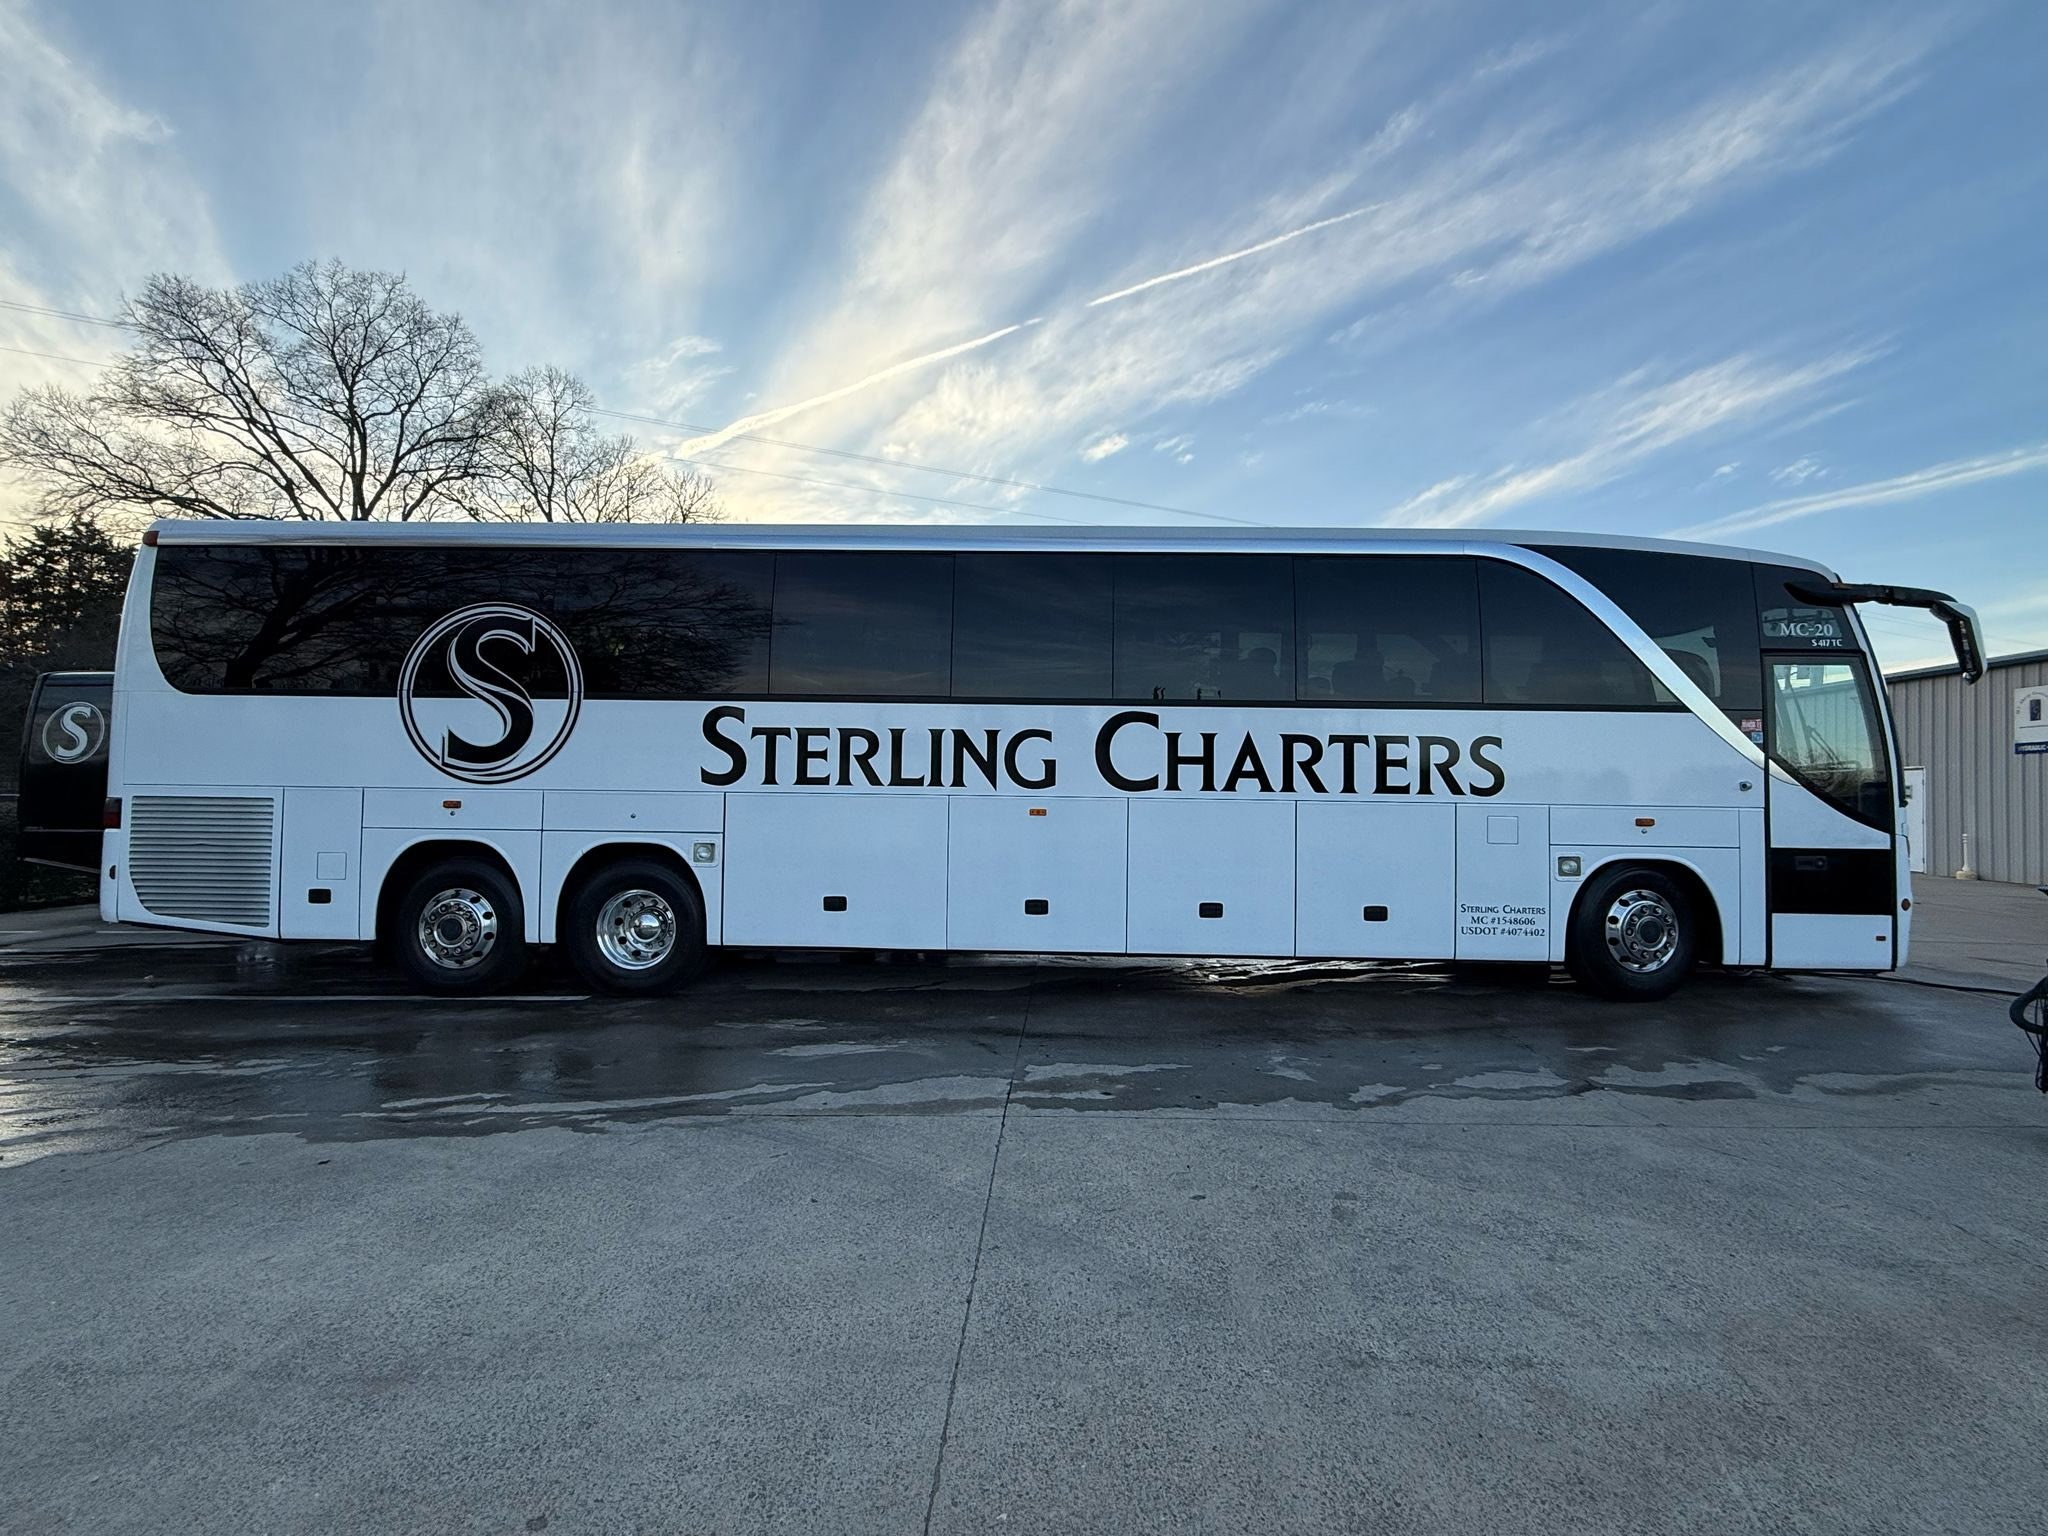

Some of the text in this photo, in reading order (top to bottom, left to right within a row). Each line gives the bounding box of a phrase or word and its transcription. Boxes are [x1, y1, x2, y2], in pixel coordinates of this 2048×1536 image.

[1780, 623, 1833, 636] MC-20
[1811, 639, 1843, 647] S 417 TC
[700, 705, 1505, 797] STERLING CHARTERS
[1460, 903, 1546, 915] STERLING CHARTERS
[1471, 916, 1536, 926] MC #1548606
[1461, 926, 1545, 937] USDOT #4074402
